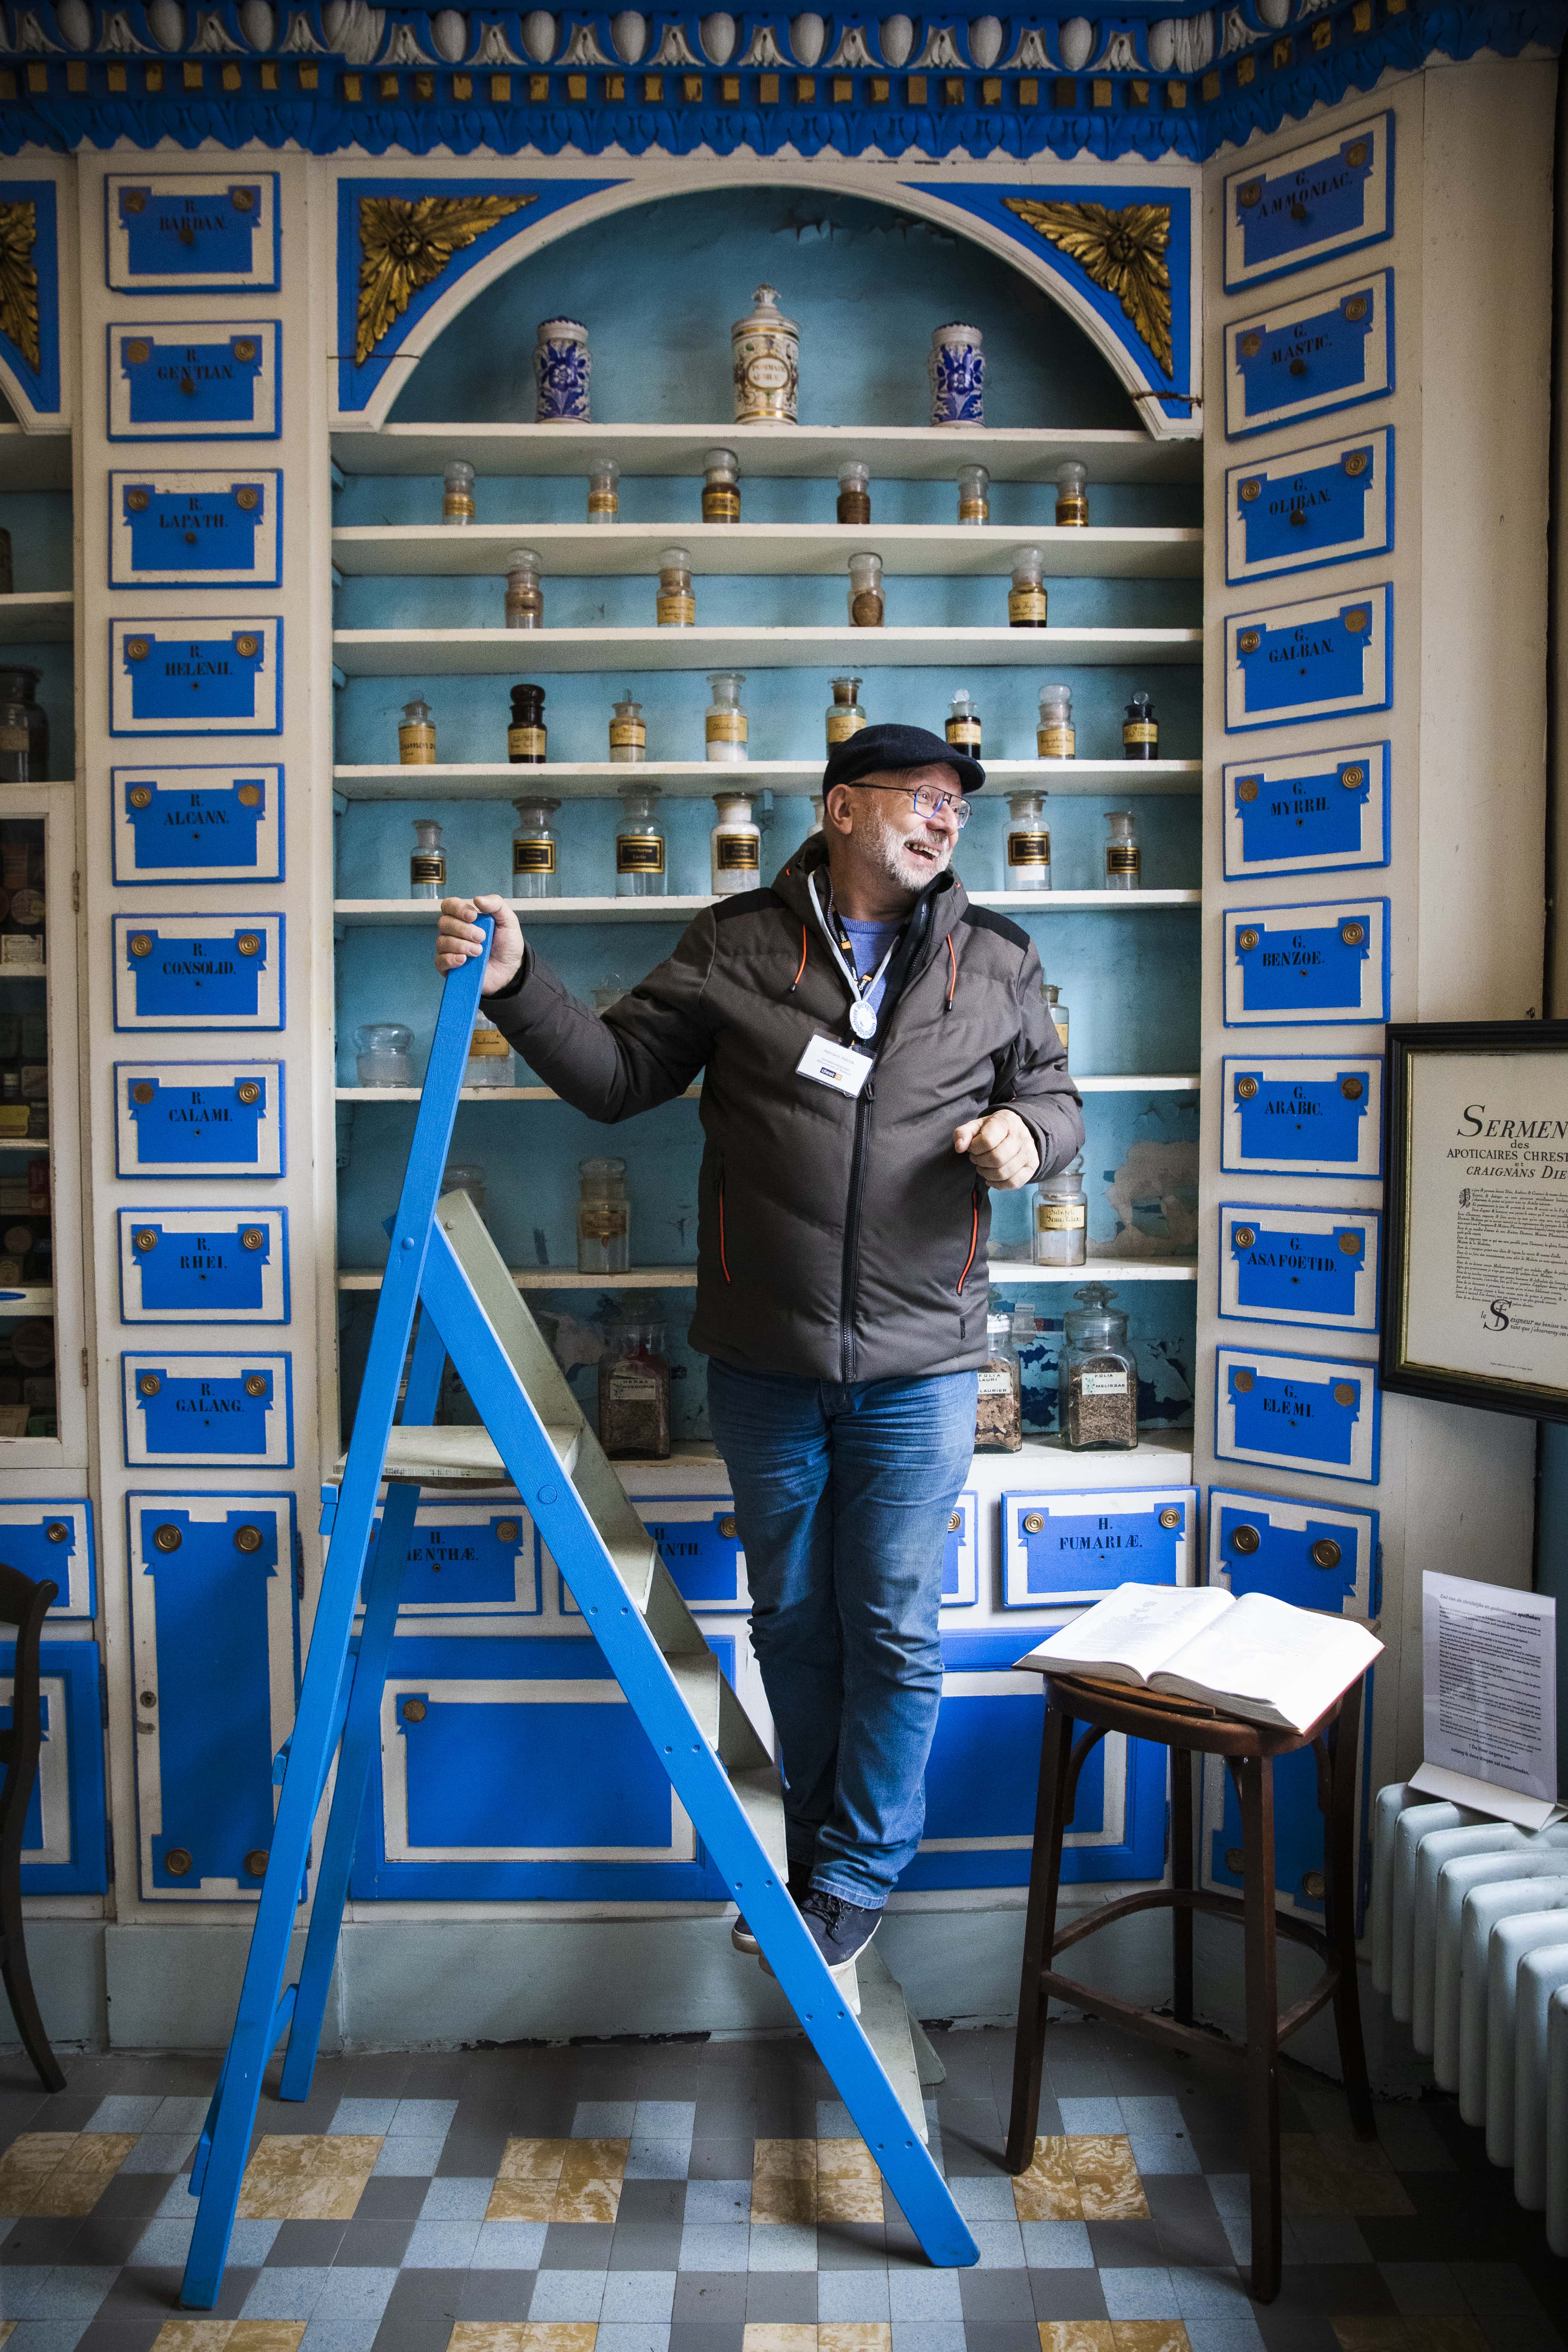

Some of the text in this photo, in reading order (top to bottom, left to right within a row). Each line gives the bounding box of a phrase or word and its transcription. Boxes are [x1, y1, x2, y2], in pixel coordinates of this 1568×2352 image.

[1256, 172, 1353, 219] AMMONIAC.
[1272, 333, 1332, 364] MASTIC.
[1269, 488, 1332, 516] OLIBAN.
[160, 515, 228, 528] LAPATH.
[1268, 639, 1334, 663] GALBAN.
[1293, 782, 1306, 795] G.
[1270, 797, 1330, 816] MYRRH.
[1292, 935, 1305, 948] G.
[193, 943, 206, 957] R.
[1262, 950, 1325, 967] BENZOE.
[163, 961, 236, 975] CONSOLID.
[821, 1068, 835, 1077] diest
[192, 1091, 205, 1105] R.
[1293, 1086, 1306, 1100] G.
[169, 1108, 233, 1122] CALAMI.
[1264, 1101, 1323, 1116] ARABIC.
[1510, 1139, 1529, 1149] des
[1446, 1148, 1518, 1160] APOTICAIRES
[1466, 1166, 1535, 1178] CRAIGNANS
[197, 1238, 210, 1251] R.
[1290, 1237, 1302, 1251] G.
[180, 1255, 227, 1269] RHEI.
[1481, 1311, 1486, 1319] le
[201, 1383, 215, 1396] R.
[1284, 1385, 1297, 1398] G.
[176, 1399, 245, 1413] GALANG.
[1098, 1518, 1113, 1530] H.
[430, 1532, 445, 1544] H.
[655, 1528, 670, 1540] H.
